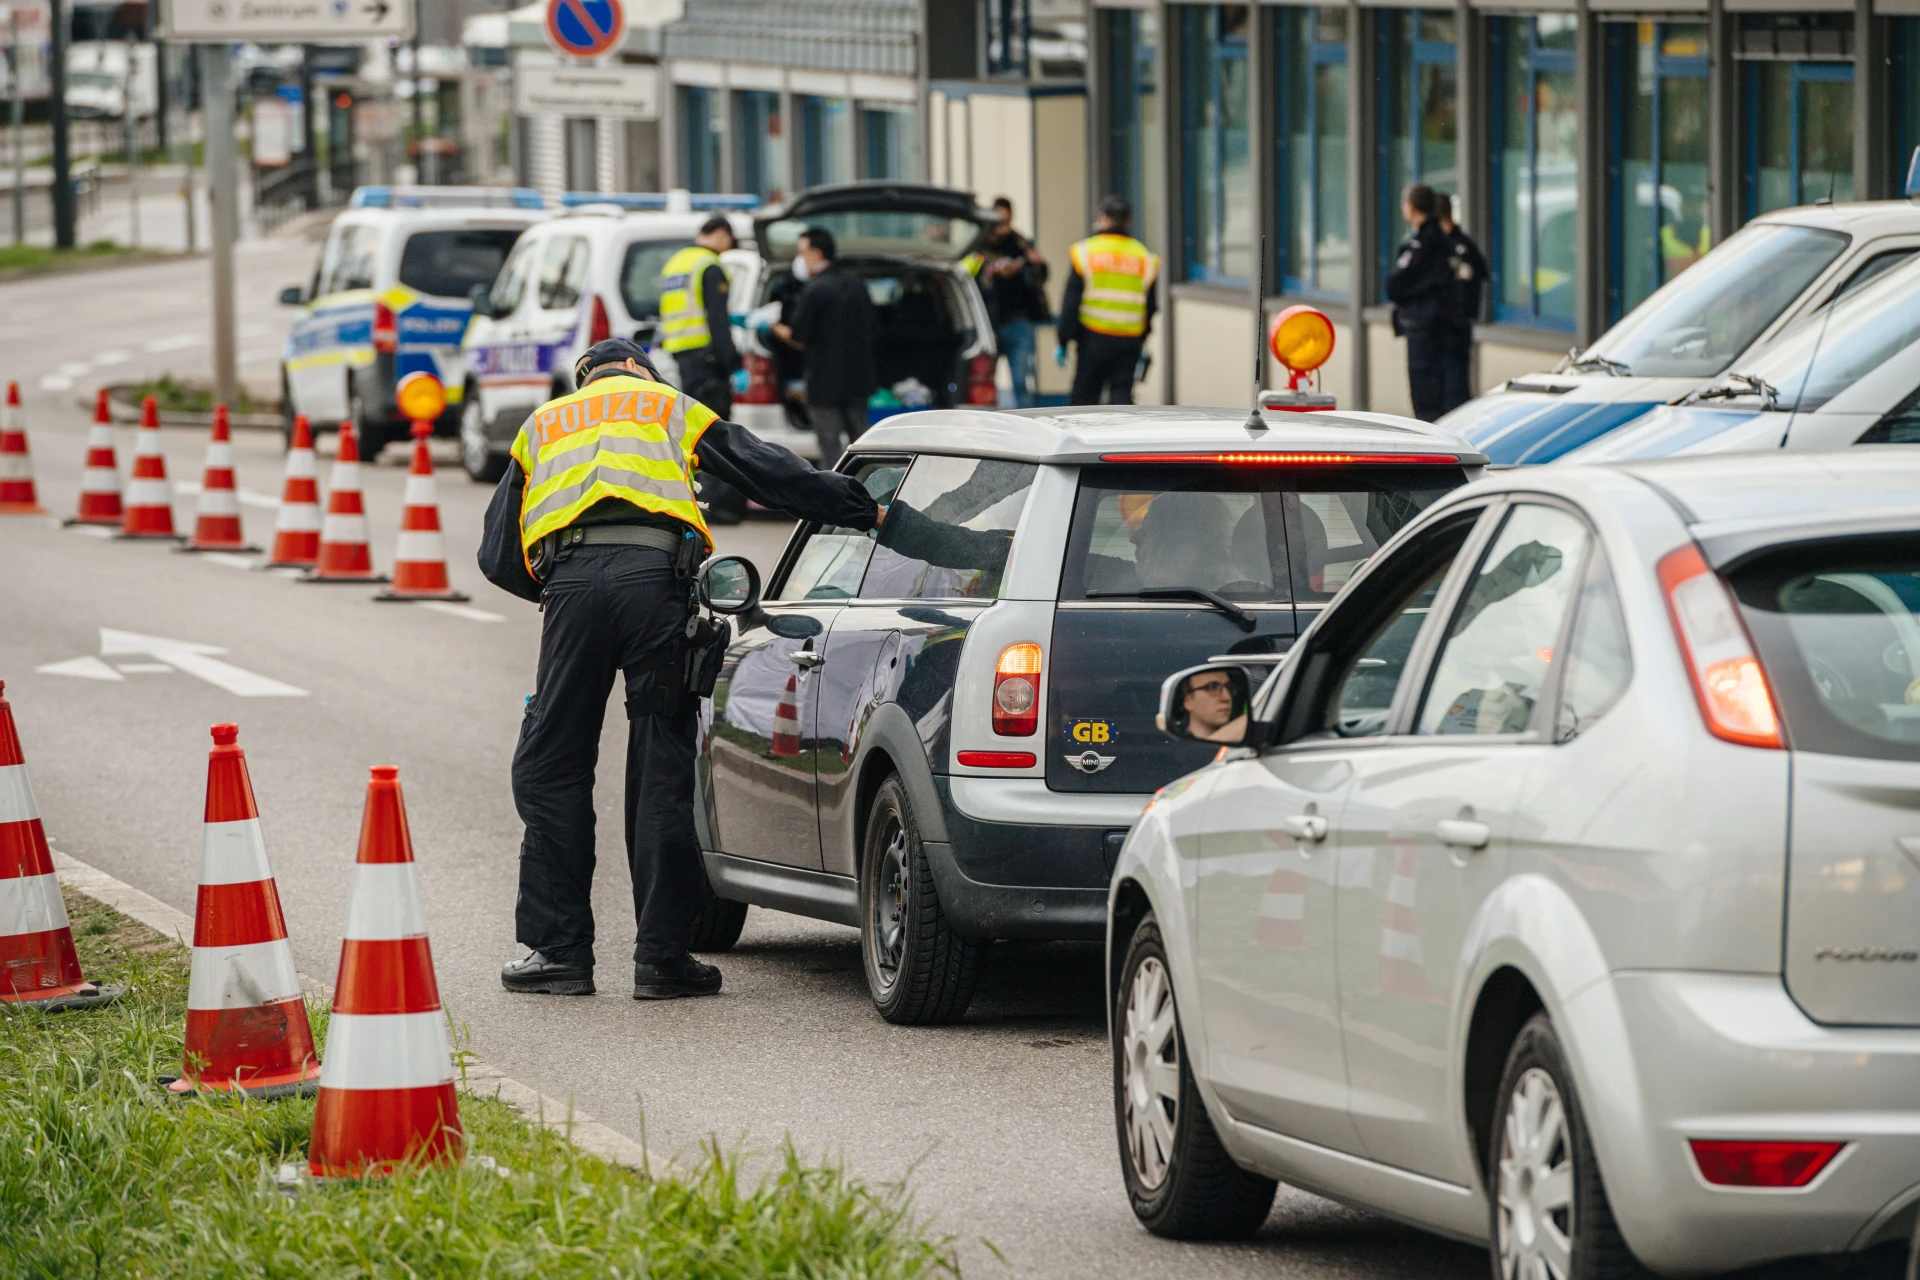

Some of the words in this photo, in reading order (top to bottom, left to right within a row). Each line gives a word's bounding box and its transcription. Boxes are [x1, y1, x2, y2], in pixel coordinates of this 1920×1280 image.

[240, 1, 318, 20] Zentrum
[540, 391, 668, 443] POLIZEI
[1072, 722, 1110, 743] GB
